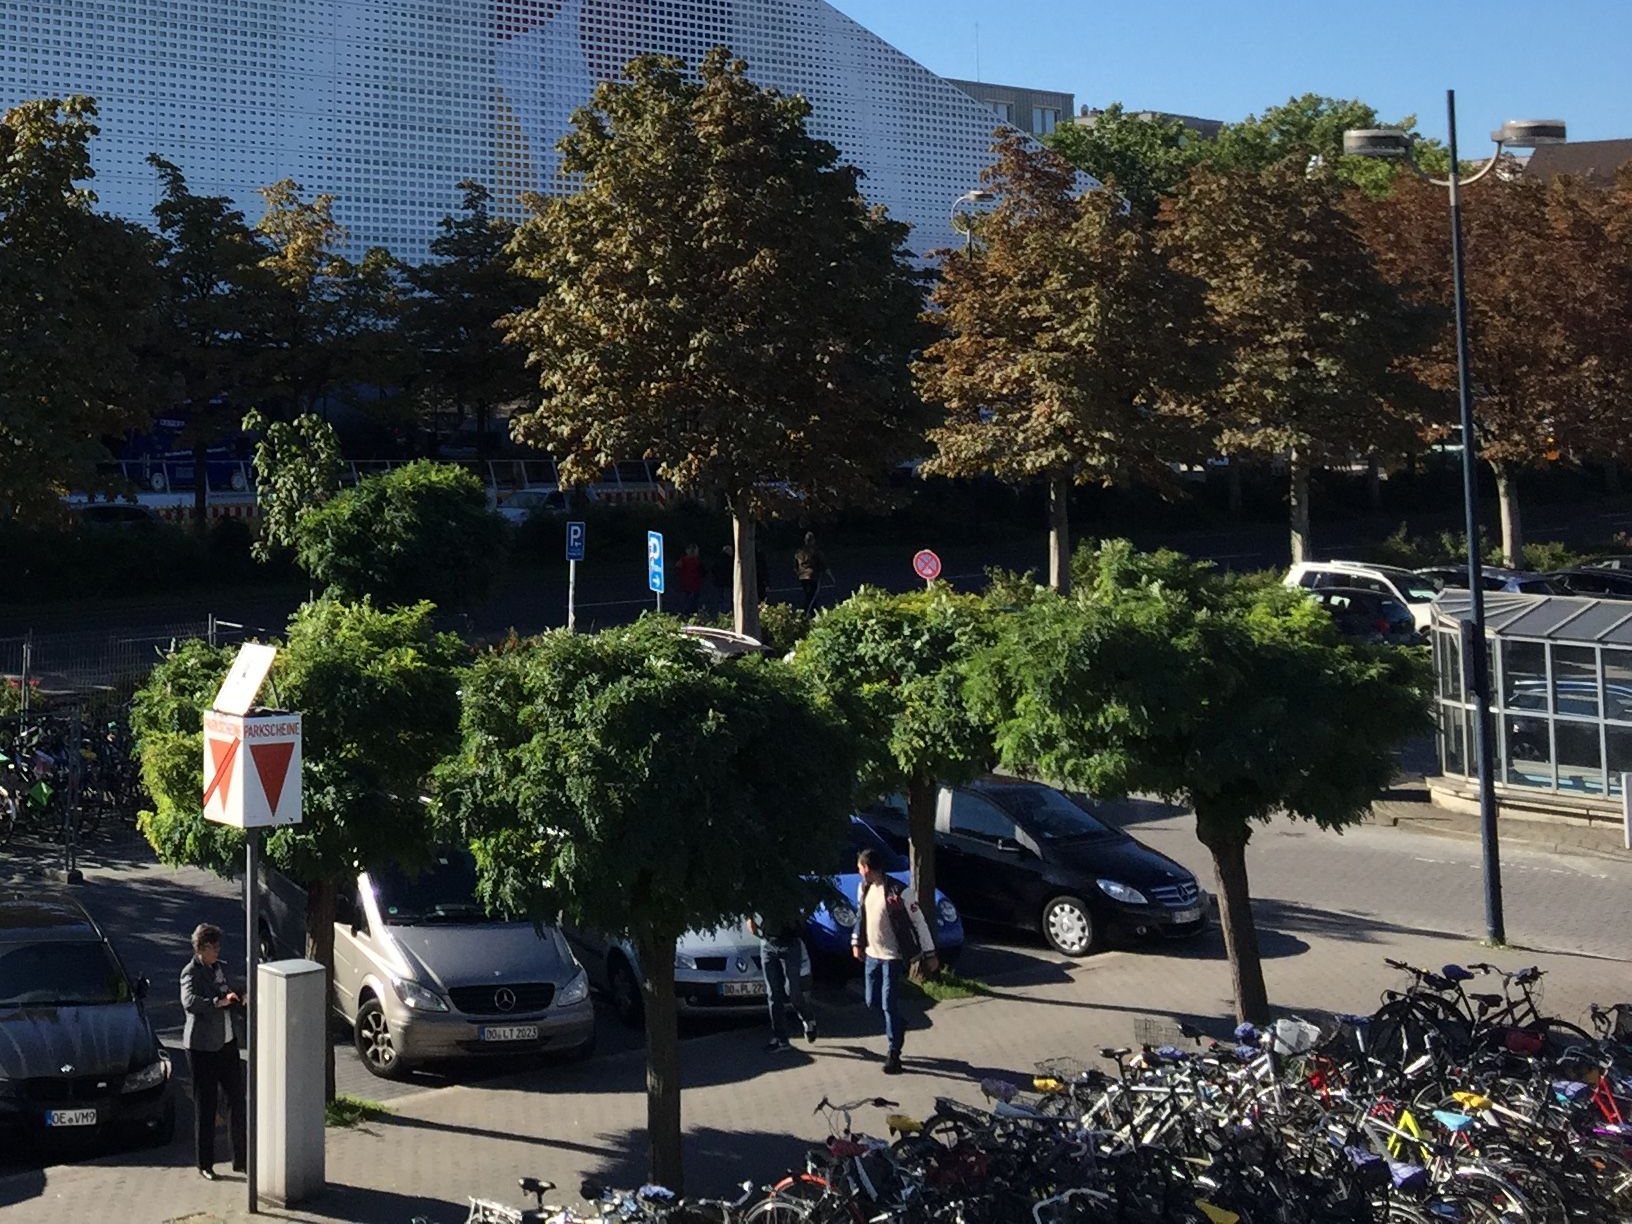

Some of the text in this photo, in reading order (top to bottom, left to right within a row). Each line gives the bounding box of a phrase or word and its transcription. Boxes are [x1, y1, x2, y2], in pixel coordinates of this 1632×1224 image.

[571, 526, 581, 547] P
[243, 722, 300, 738] PARKSCHEINE
[52, 1113, 66, 1124] OE
